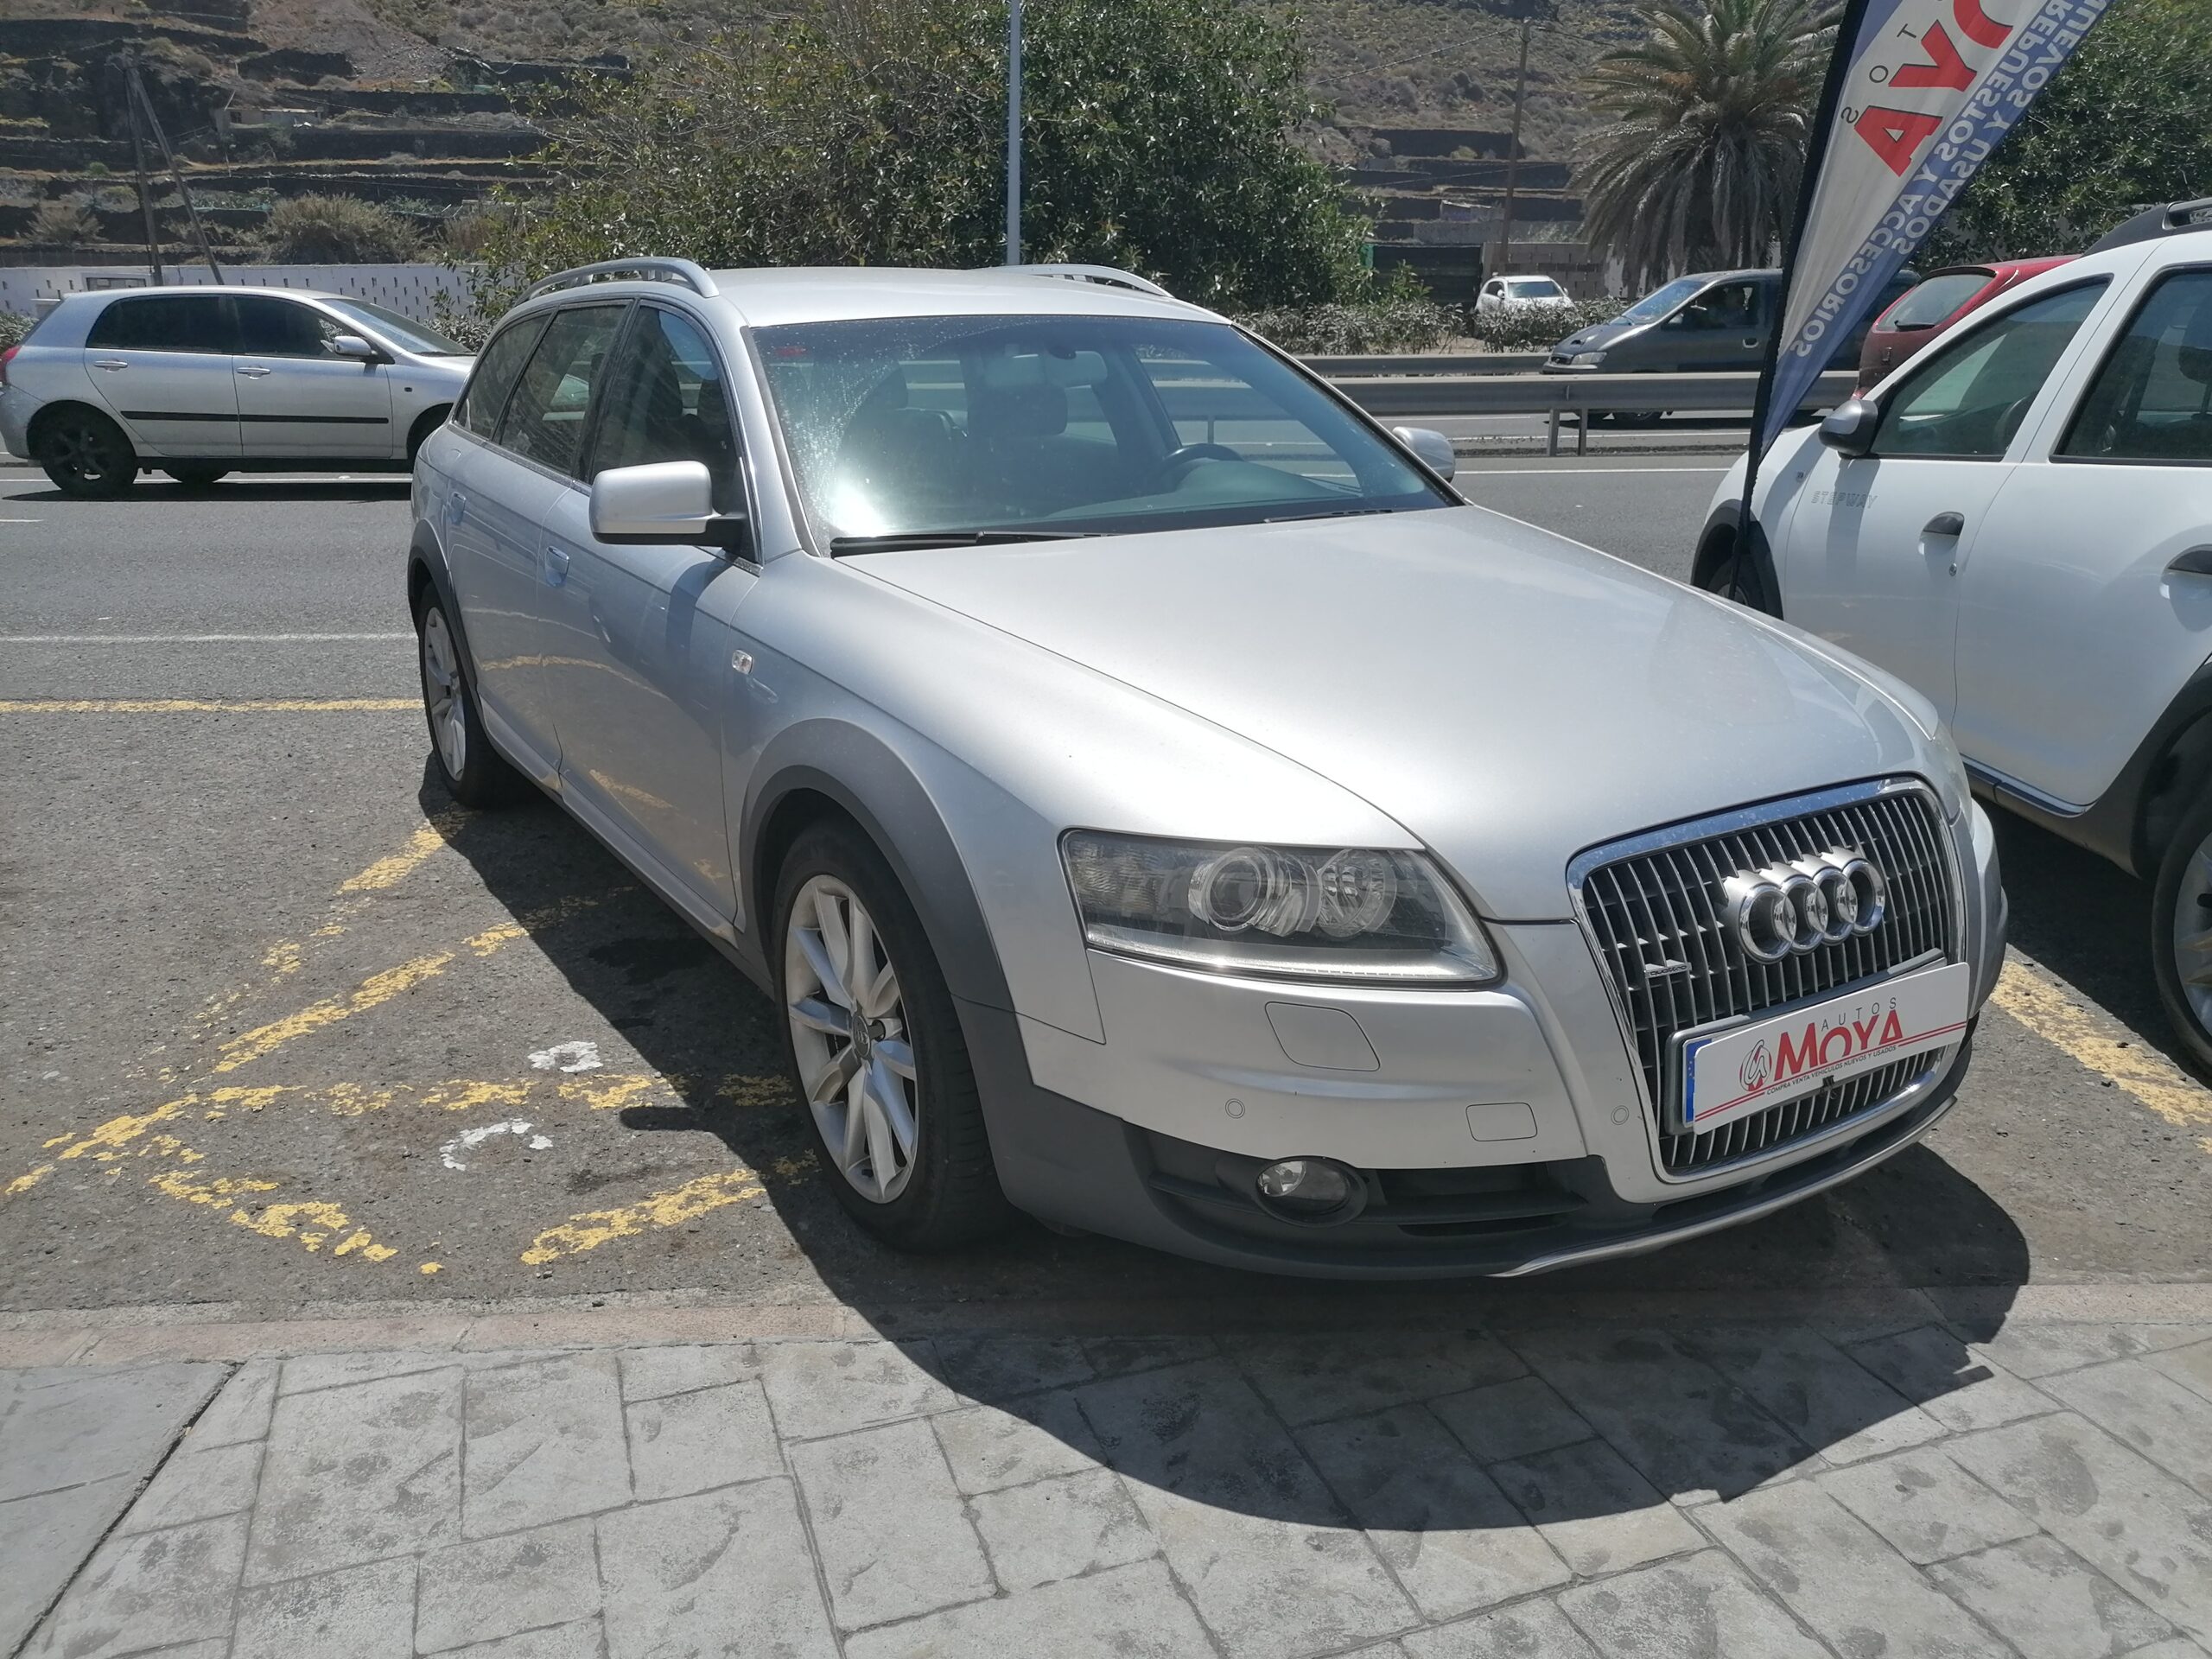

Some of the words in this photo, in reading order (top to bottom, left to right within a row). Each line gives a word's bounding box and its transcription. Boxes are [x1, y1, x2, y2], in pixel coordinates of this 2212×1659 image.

[1811, 491, 1878, 509] STEPWAY
[1821, 998, 1897, 1031] AUTOS
[1774, 1009, 1904, 1081] MOYA
[1767, 1082, 1791, 1096] COMPRA
[1792, 1074, 1811, 1086] VENTA
[1811, 1062, 1843, 1078] VEHICULOS
[1844, 1055, 1867, 1068] NUEVOS
[1873, 1046, 1897, 1058] USADOS
